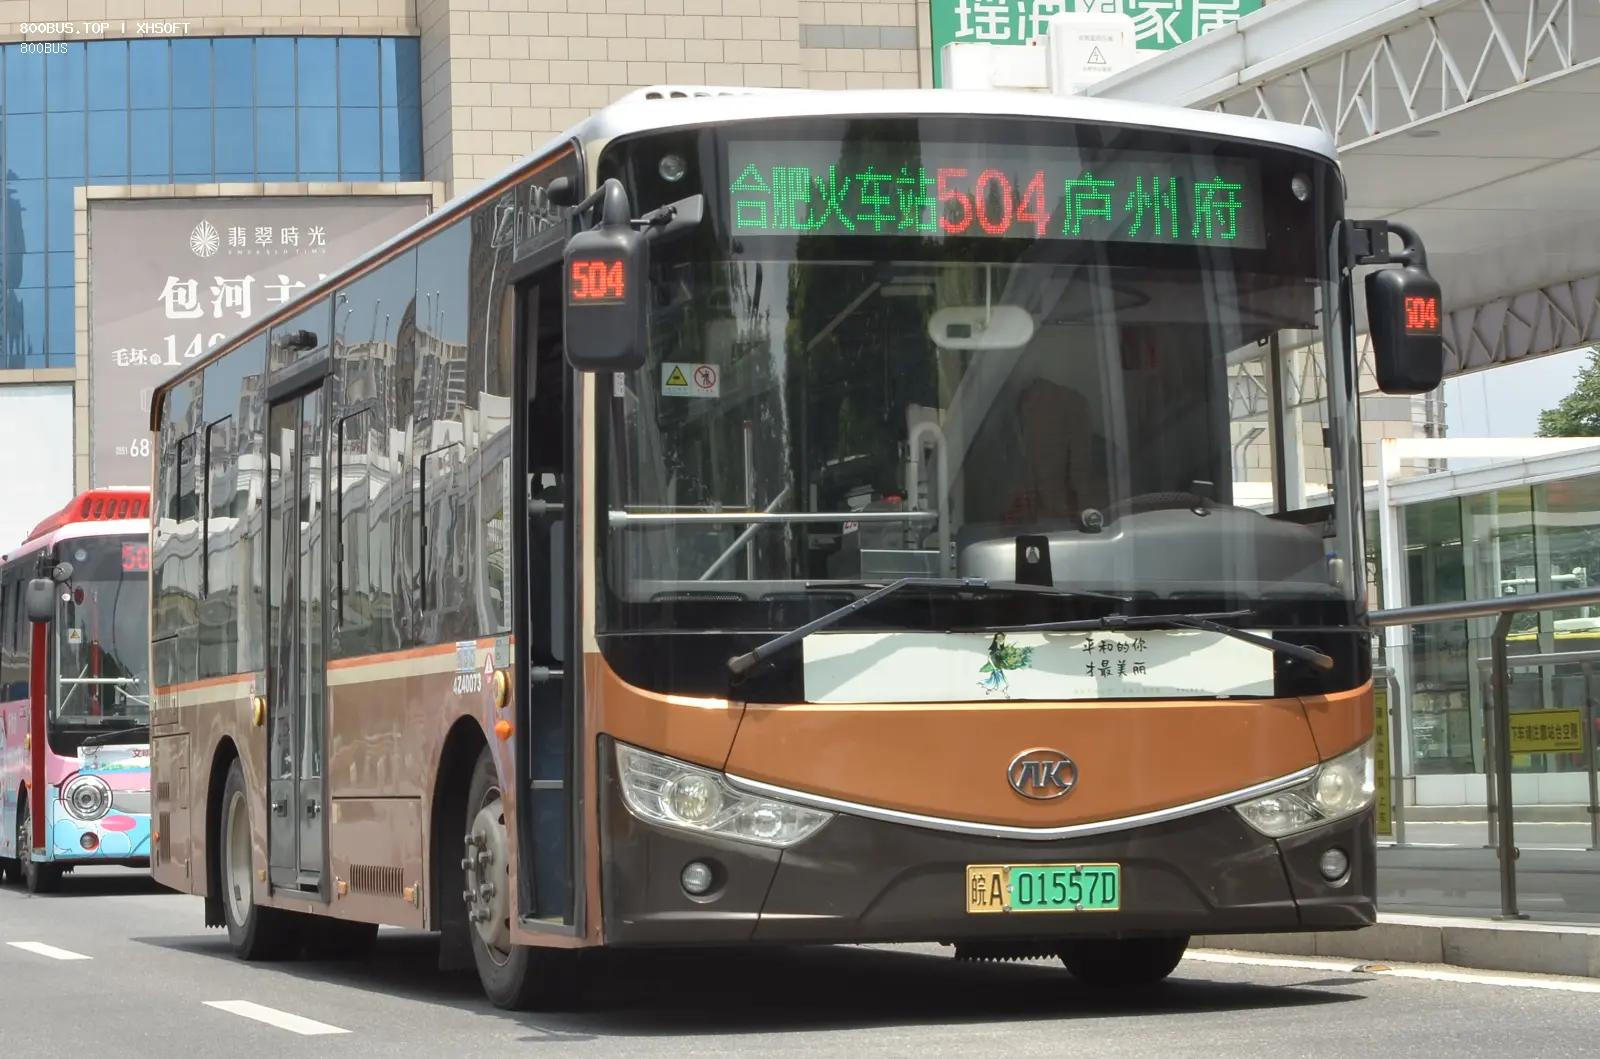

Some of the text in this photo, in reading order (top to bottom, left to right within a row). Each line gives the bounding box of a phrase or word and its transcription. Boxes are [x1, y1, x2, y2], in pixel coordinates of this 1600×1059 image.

[730, 164, 1243, 239] 合肥火车站 504 庐州府
[228, 226, 326, 247] 翡翠時光
[572, 261, 625, 298] 504
[158, 274, 328, 319] 包河主
[1405, 297, 1438, 328] 504
[1082, 637, 1147, 655] 平和的你
[1085, 659, 1147, 677] 才最美丽
